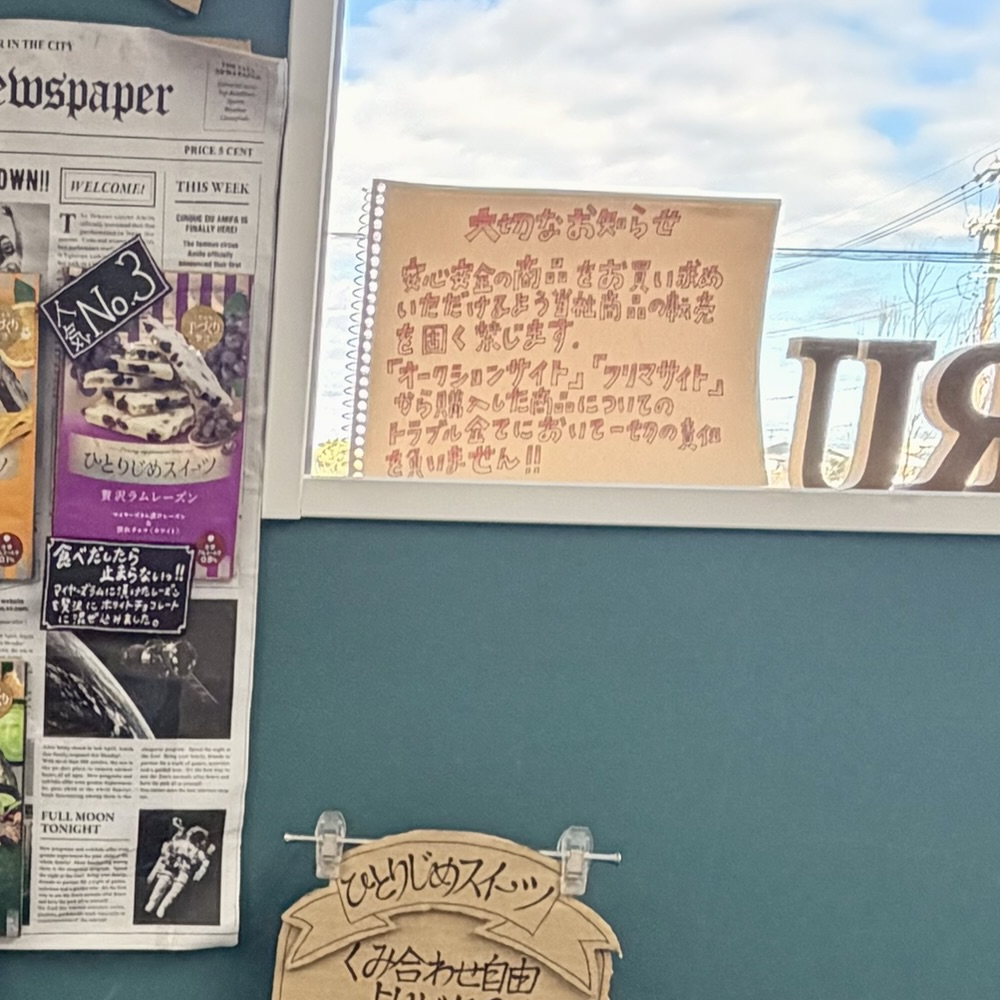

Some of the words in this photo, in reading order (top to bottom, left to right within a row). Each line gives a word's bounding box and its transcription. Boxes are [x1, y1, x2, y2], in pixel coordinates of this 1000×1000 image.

[7, 39, 20, 49] IN
[184, 145, 216, 156] PRICE
[226, 147, 254, 158] CENT
[70, 180, 147, 196] WELCOME!
[175, 181, 209, 194] THIS
[211, 182, 250, 195] WEEK
[465, 203, 682, 244] 大切なお知らせ
[401, 255, 725, 294] 安心安全の商品をお買い求め
[76, 249, 156, 337] No.3
[84, 452, 217, 479] ひとりじめスイーツ
[101, 488, 198, 504] 贅沢ラムレーズン
[53, 543, 140, 569] 食べだしたら
[41, 811, 72, 822] FULL
[75, 812, 115, 823] MOON
[40, 824, 101, 835] TONIGHT
[341, 850, 555, 913] ひとりじめスイーツ
[343, 941, 541, 995] くみ合わせ自由
